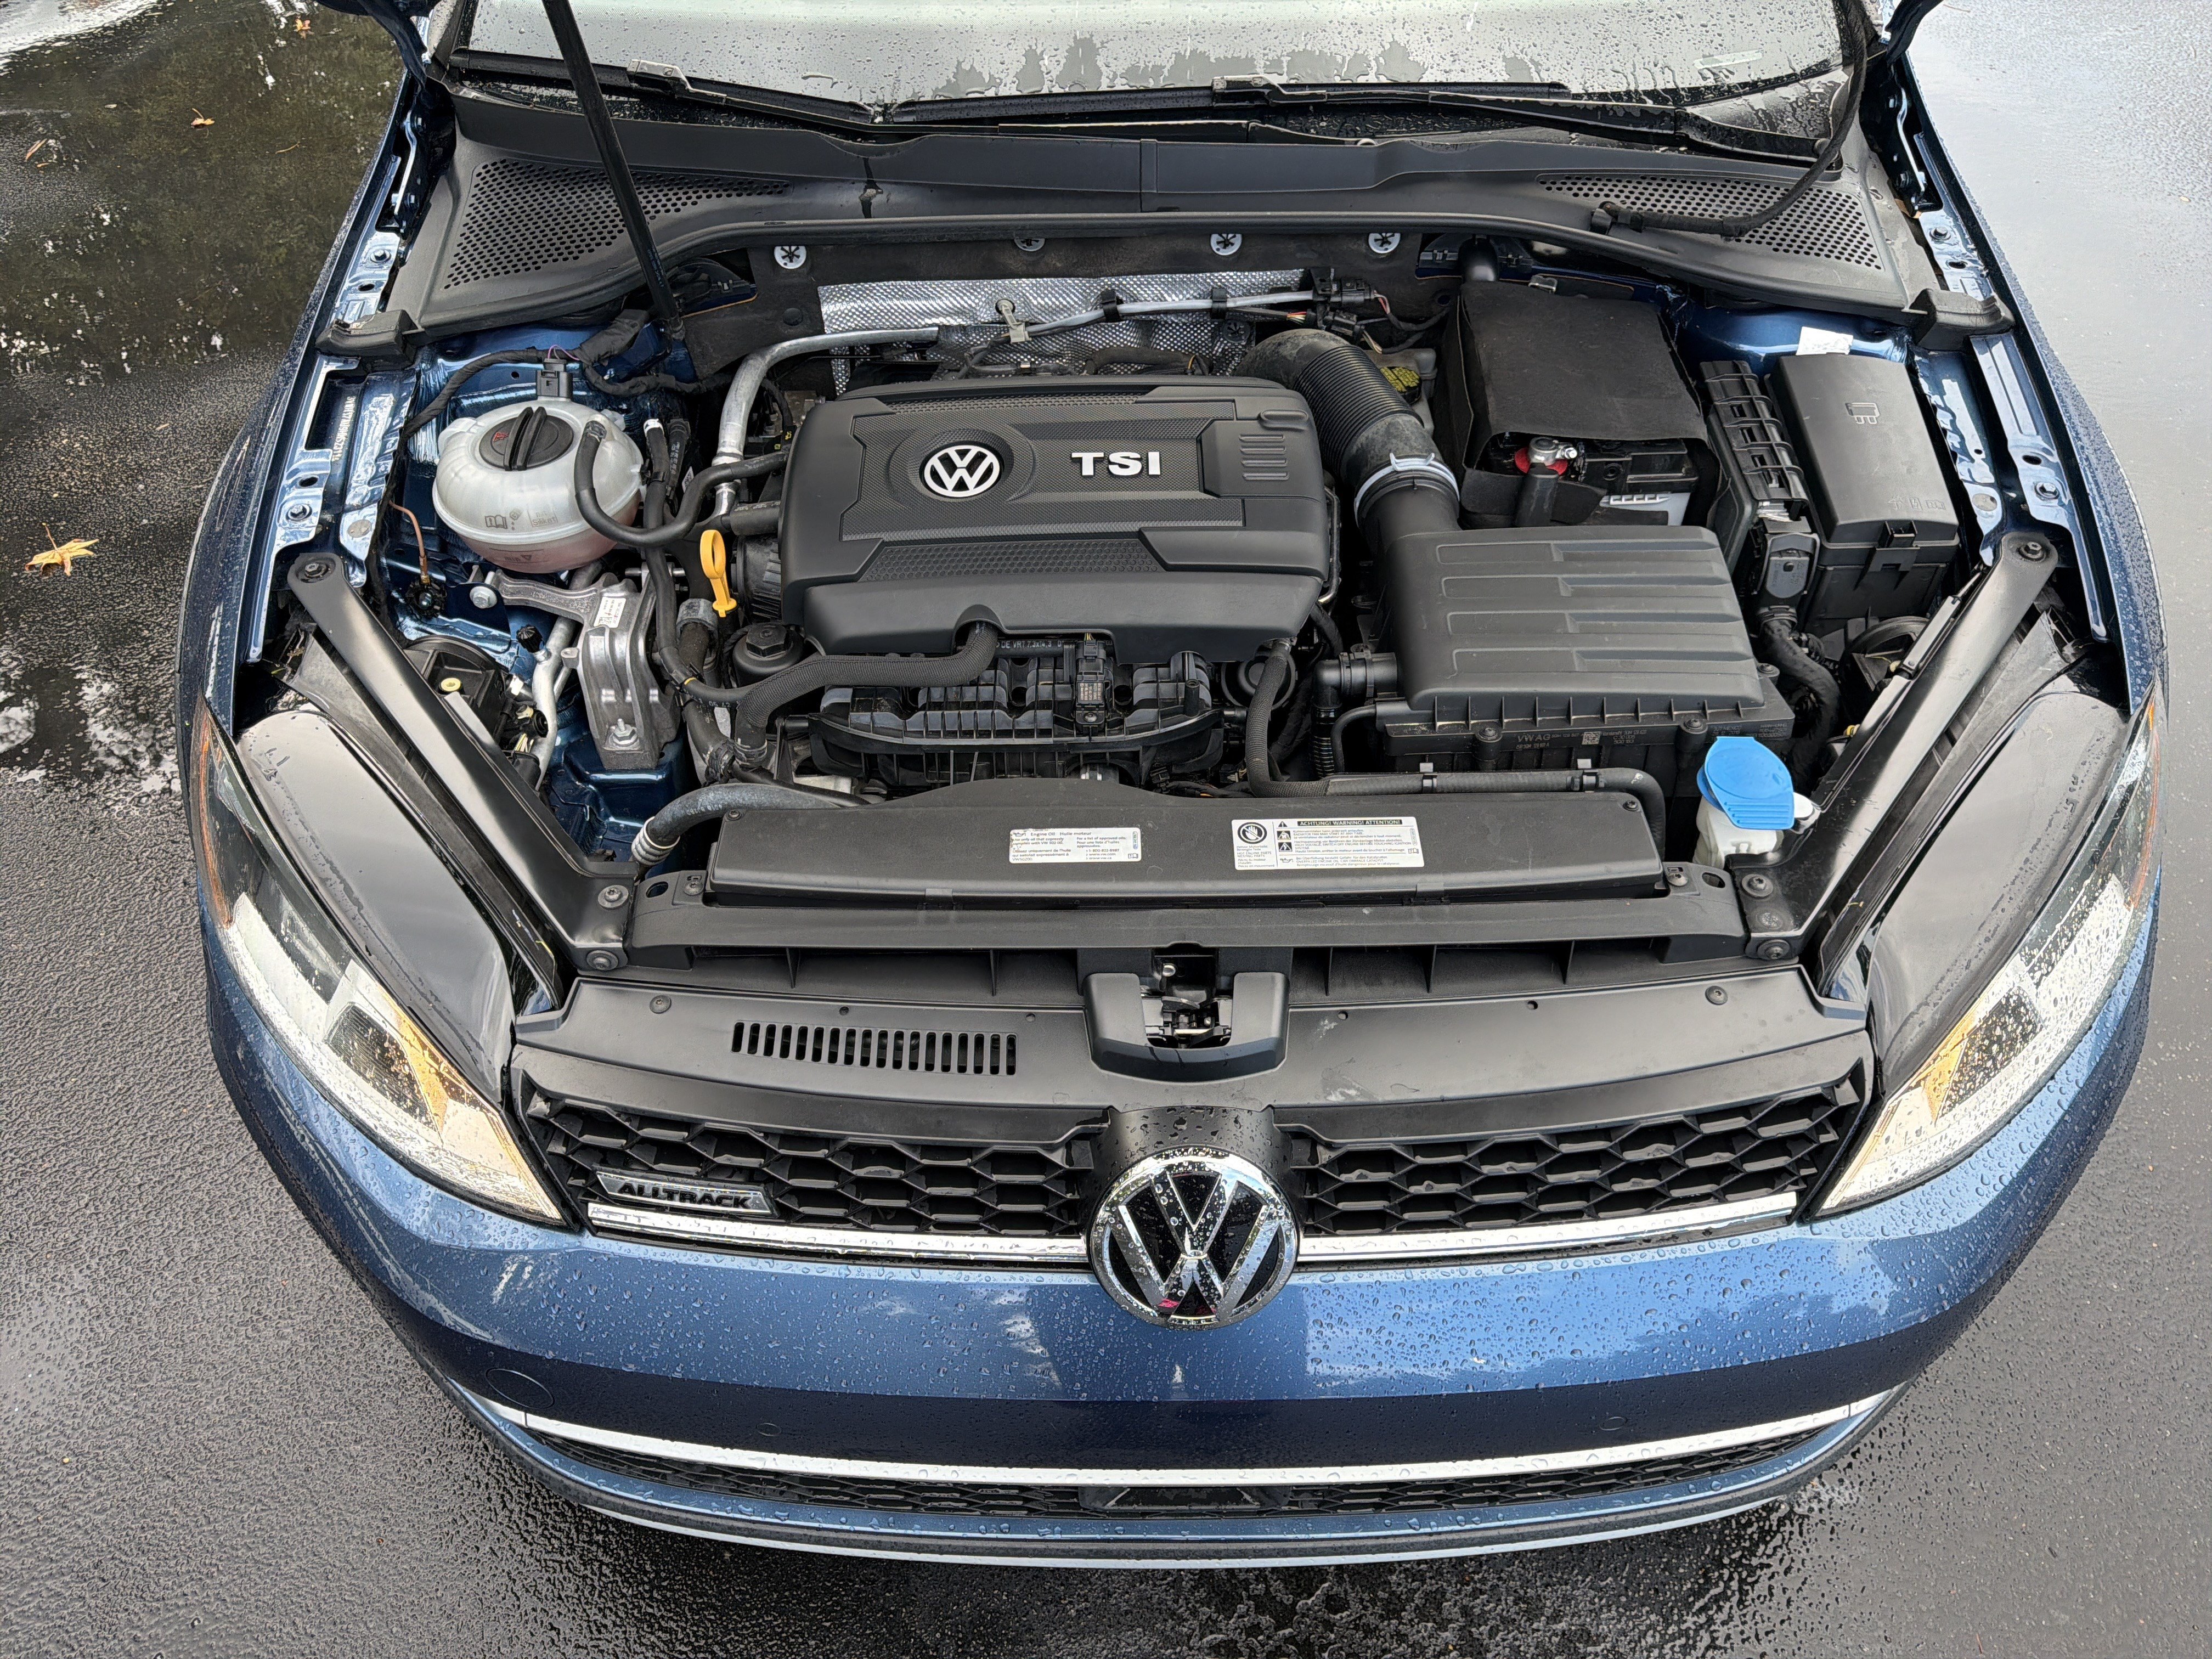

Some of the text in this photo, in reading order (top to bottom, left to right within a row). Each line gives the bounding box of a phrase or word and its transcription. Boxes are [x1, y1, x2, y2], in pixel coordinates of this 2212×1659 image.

[924, 445, 1160, 498] VW TSI
[533, 517, 556, 526] Silikat
[617, 1182, 752, 1208] ALLTRACK
[1090, 1146, 1299, 1330] VW
